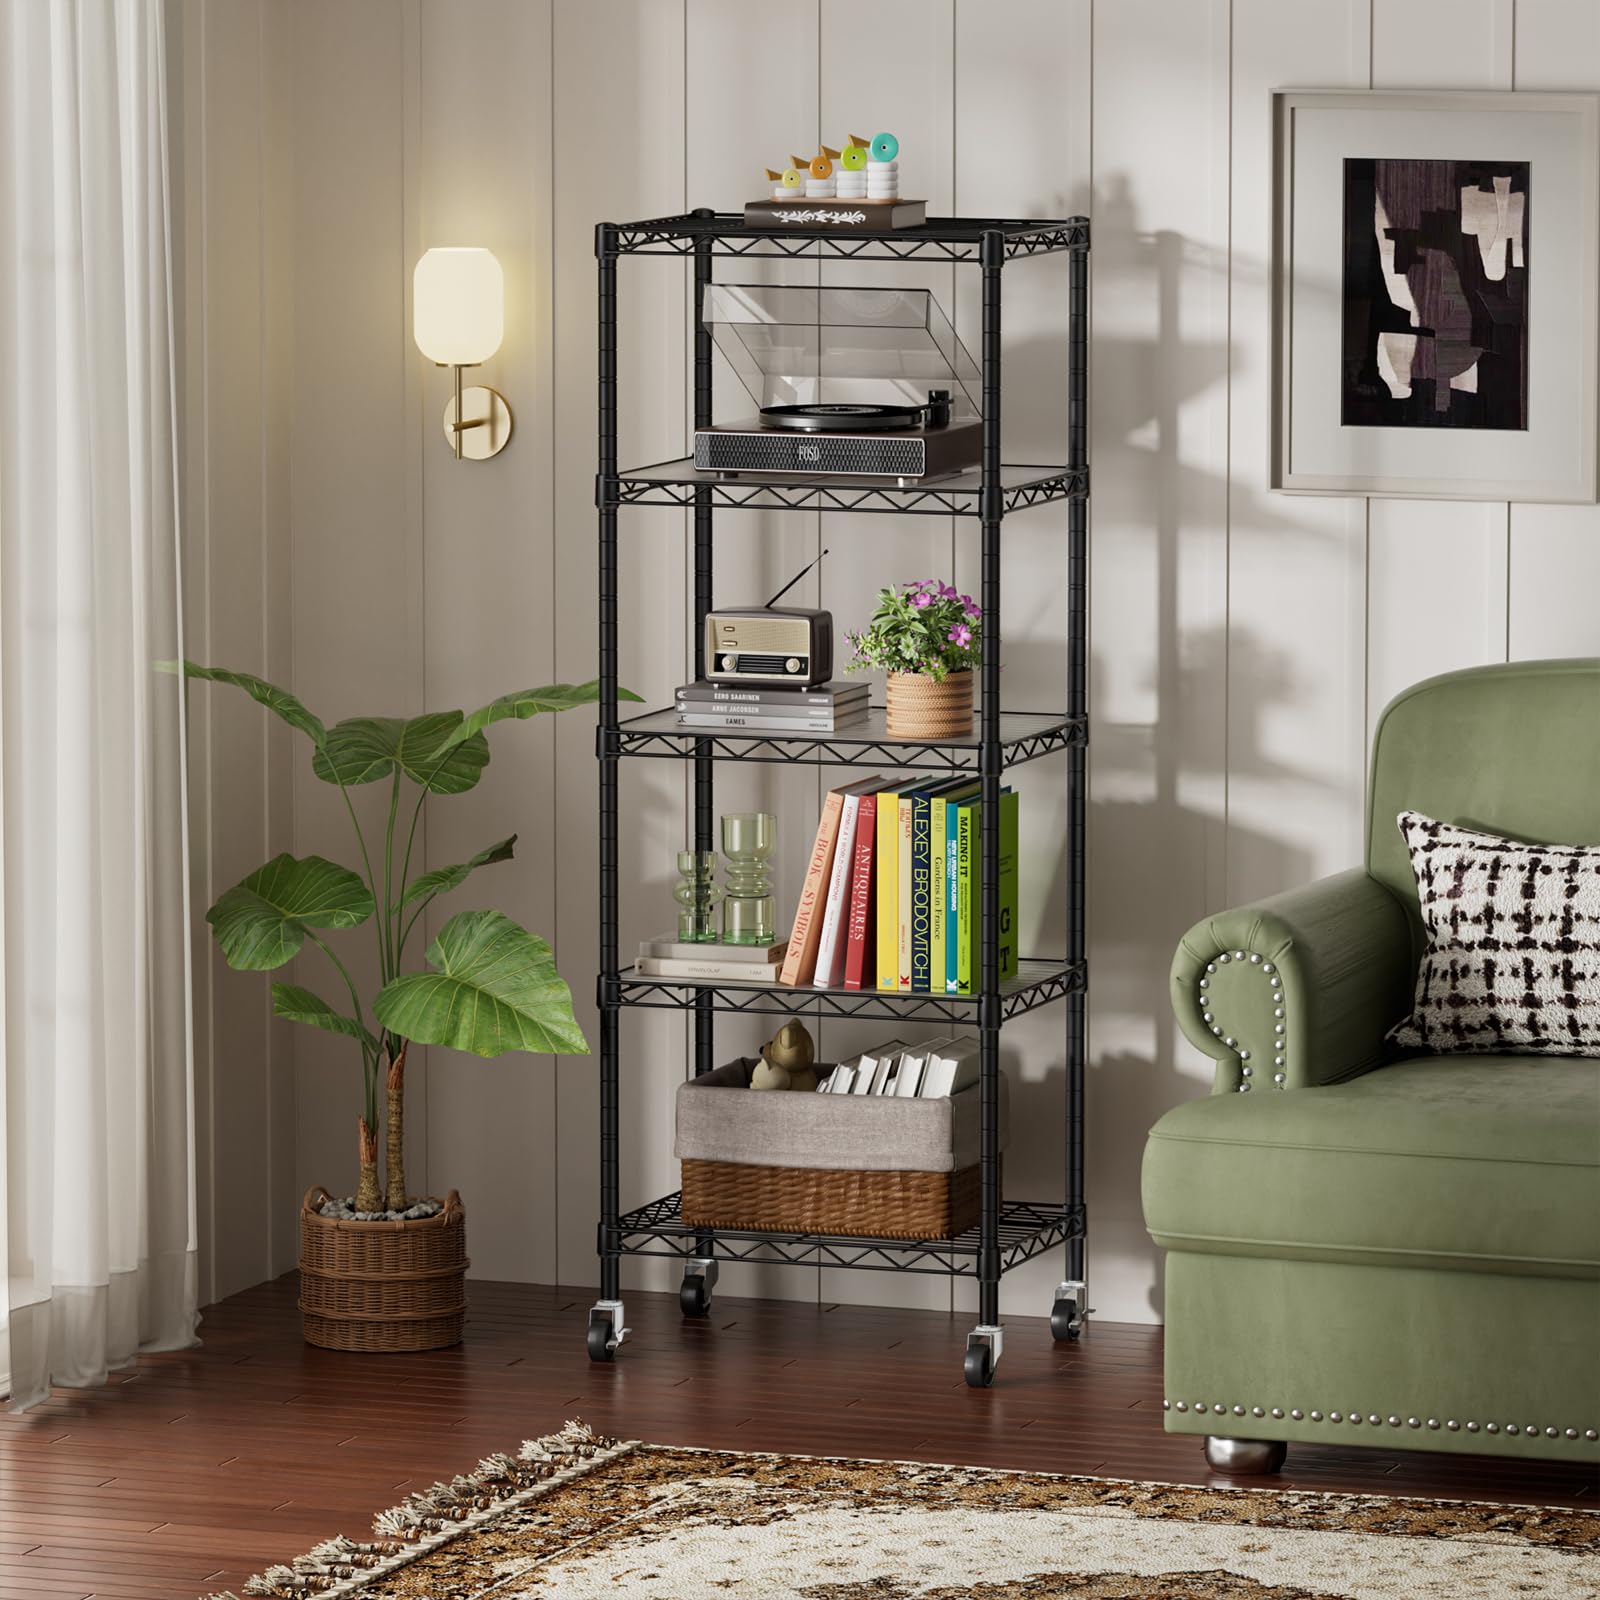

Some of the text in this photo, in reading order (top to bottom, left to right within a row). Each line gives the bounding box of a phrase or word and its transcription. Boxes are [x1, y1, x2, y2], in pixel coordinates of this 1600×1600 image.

[714, 692, 760, 702] EERO SAARINEN
[729, 706, 760, 714] JACOBSEN
[726, 718, 746, 726] EAMES
[913, 797, 929, 864] ALEXEY
[960, 816, 968, 863] MAKING
[809, 838, 829, 879] BOOK
[960, 865, 968, 878] IT
[832, 865, 844, 901] CHAMPIONS
[855, 845, 871, 941] ANTIQUAIRES
[935, 856, 943, 941] Gardens in France
[789, 890, 815, 958] SYMBOLS
[913, 869, 929, 979] BRODOVITCH
